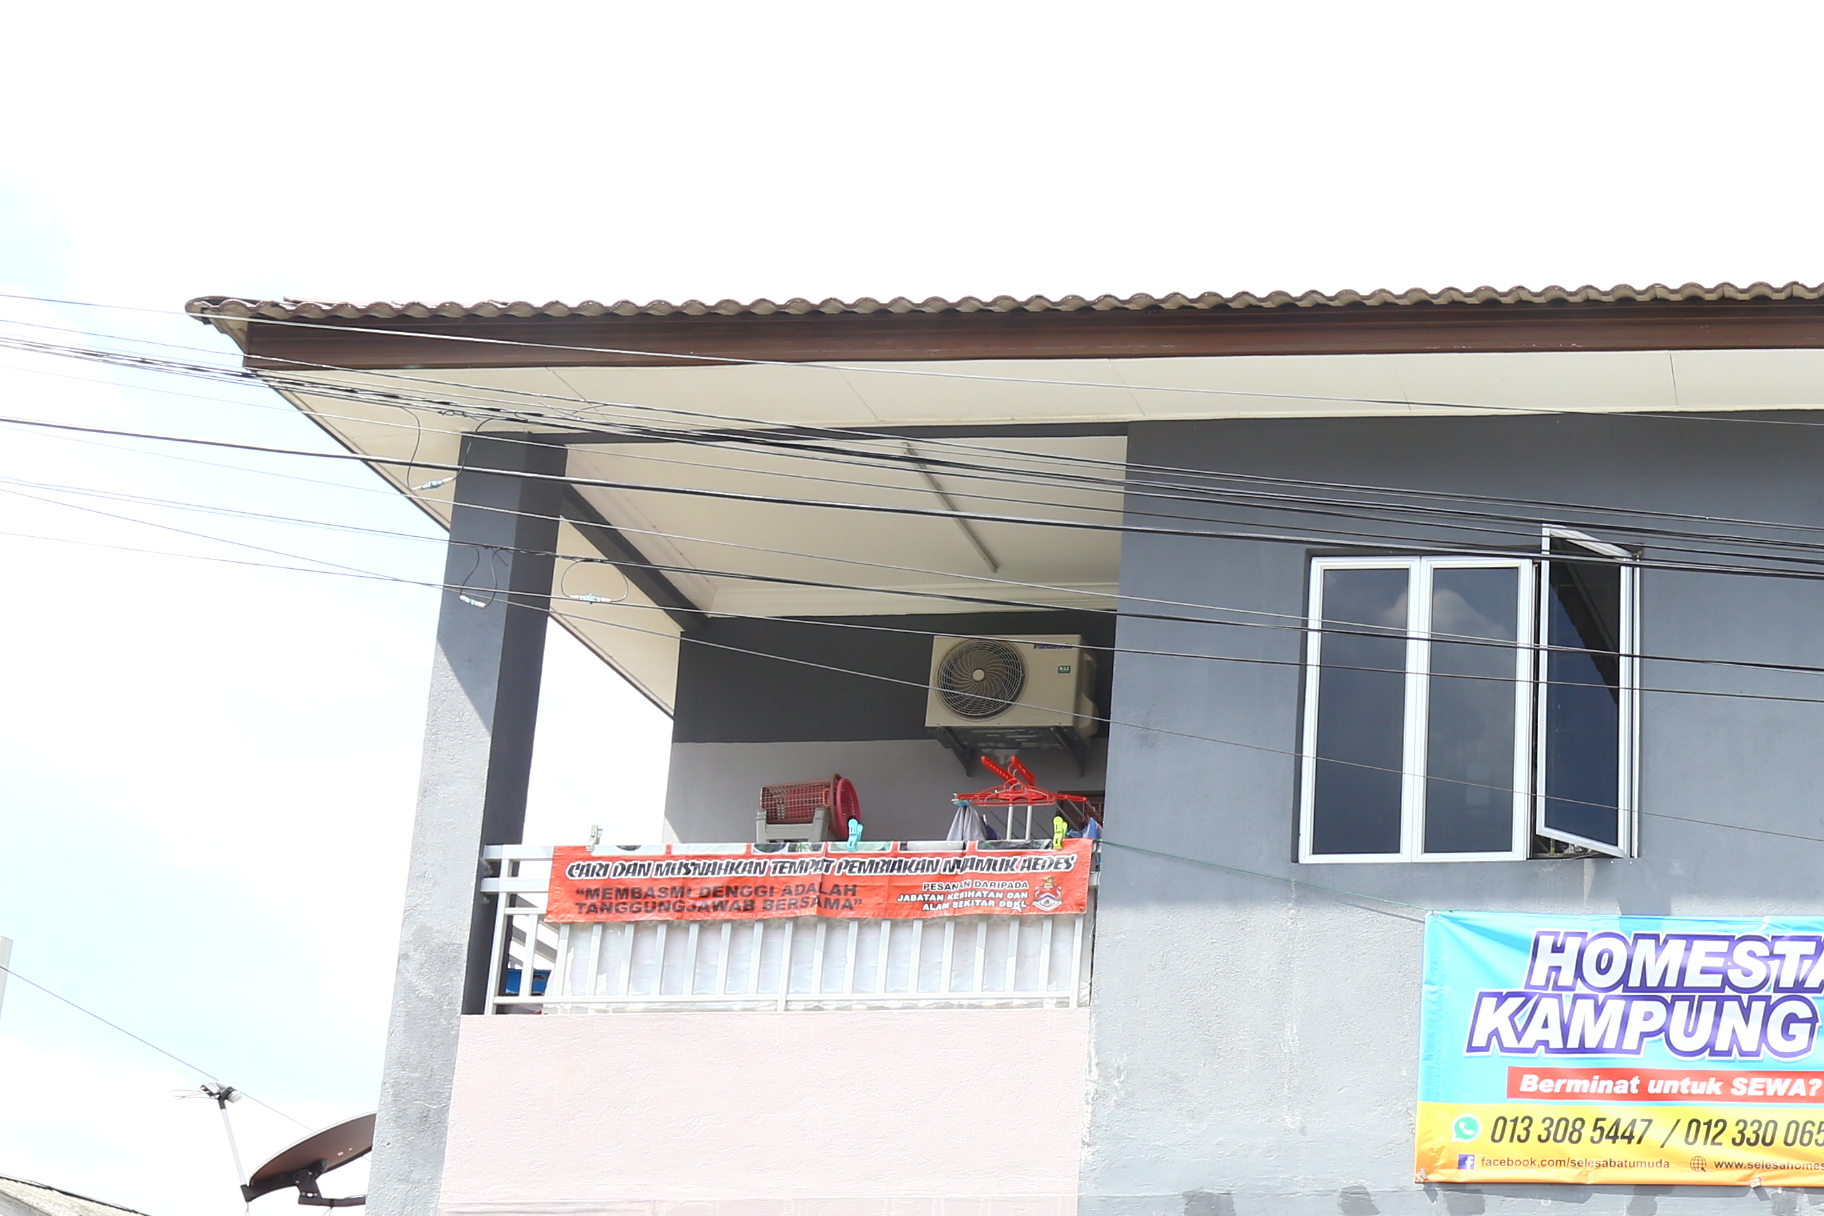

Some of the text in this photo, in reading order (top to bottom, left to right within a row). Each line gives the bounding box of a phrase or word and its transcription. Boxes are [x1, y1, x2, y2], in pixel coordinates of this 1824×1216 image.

[567, 854, 1078, 880] CARI DAN MUSNAHKAN TEMPAT PEMBIAKAN NYAMUK AEDES
[700, 883, 774, 899] DENGGI
[781, 882, 857, 897] ADALAH
[923, 879, 1029, 891] PESANAN DARIPADA
[897, 890, 1028, 902] JABATAN KESIHATAN DAN
[576, 900, 755, 915] TANGGUNGJAWAB
[922, 902, 950, 912] ALAM
[952, 899, 996, 909] SEKITAR
[1466, 991, 1818, 1058] KAMPUNG
[1520, 1073, 1640, 1095] Berminat
[1647, 1076, 1724, 1097] untuk
[1731, 1077, 1823, 1098] SEWA?
[1490, 1115, 1534, 1144] 013
[1537, 1116, 1586, 1145] 308
[1589, 1117, 1654, 1146] 5447
[1684, 1118, 1728, 1147] 012
[1731, 1119, 1779, 1148] 330
[1480, 1156, 1671, 1170] facebook.com/selesabatumuda
